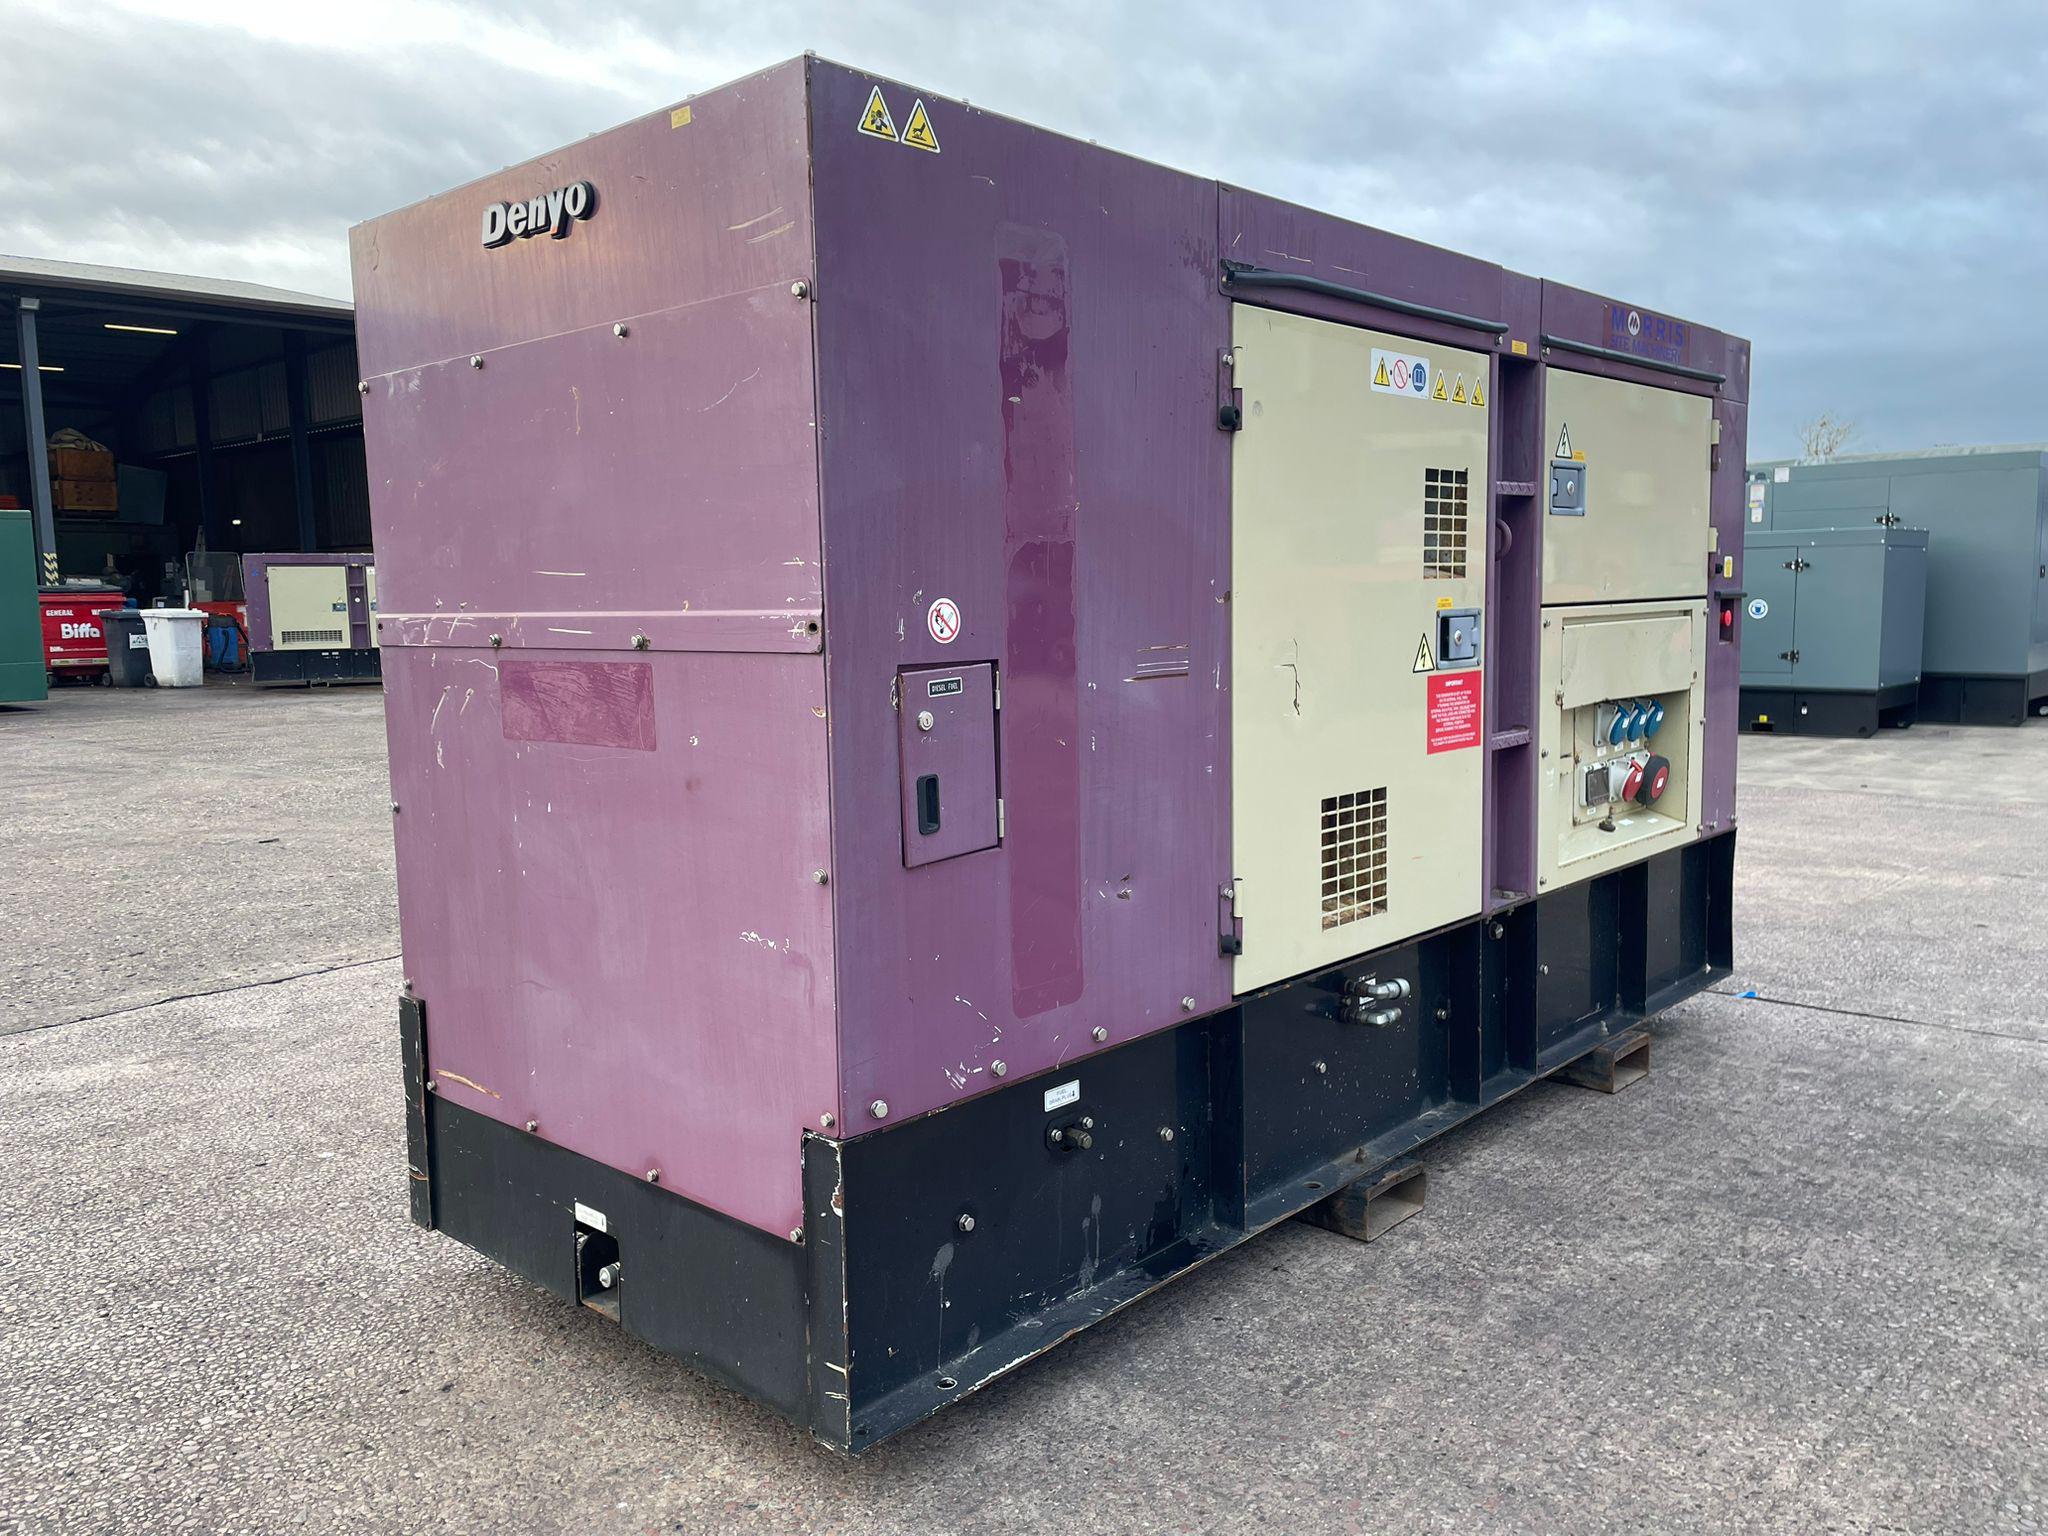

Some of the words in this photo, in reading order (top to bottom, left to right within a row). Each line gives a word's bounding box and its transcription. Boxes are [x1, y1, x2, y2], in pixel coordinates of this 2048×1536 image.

[481, 181, 595, 249] Denyo
[1611, 305, 1685, 347] MORRIS
[61, 623, 100, 639] Biffa
